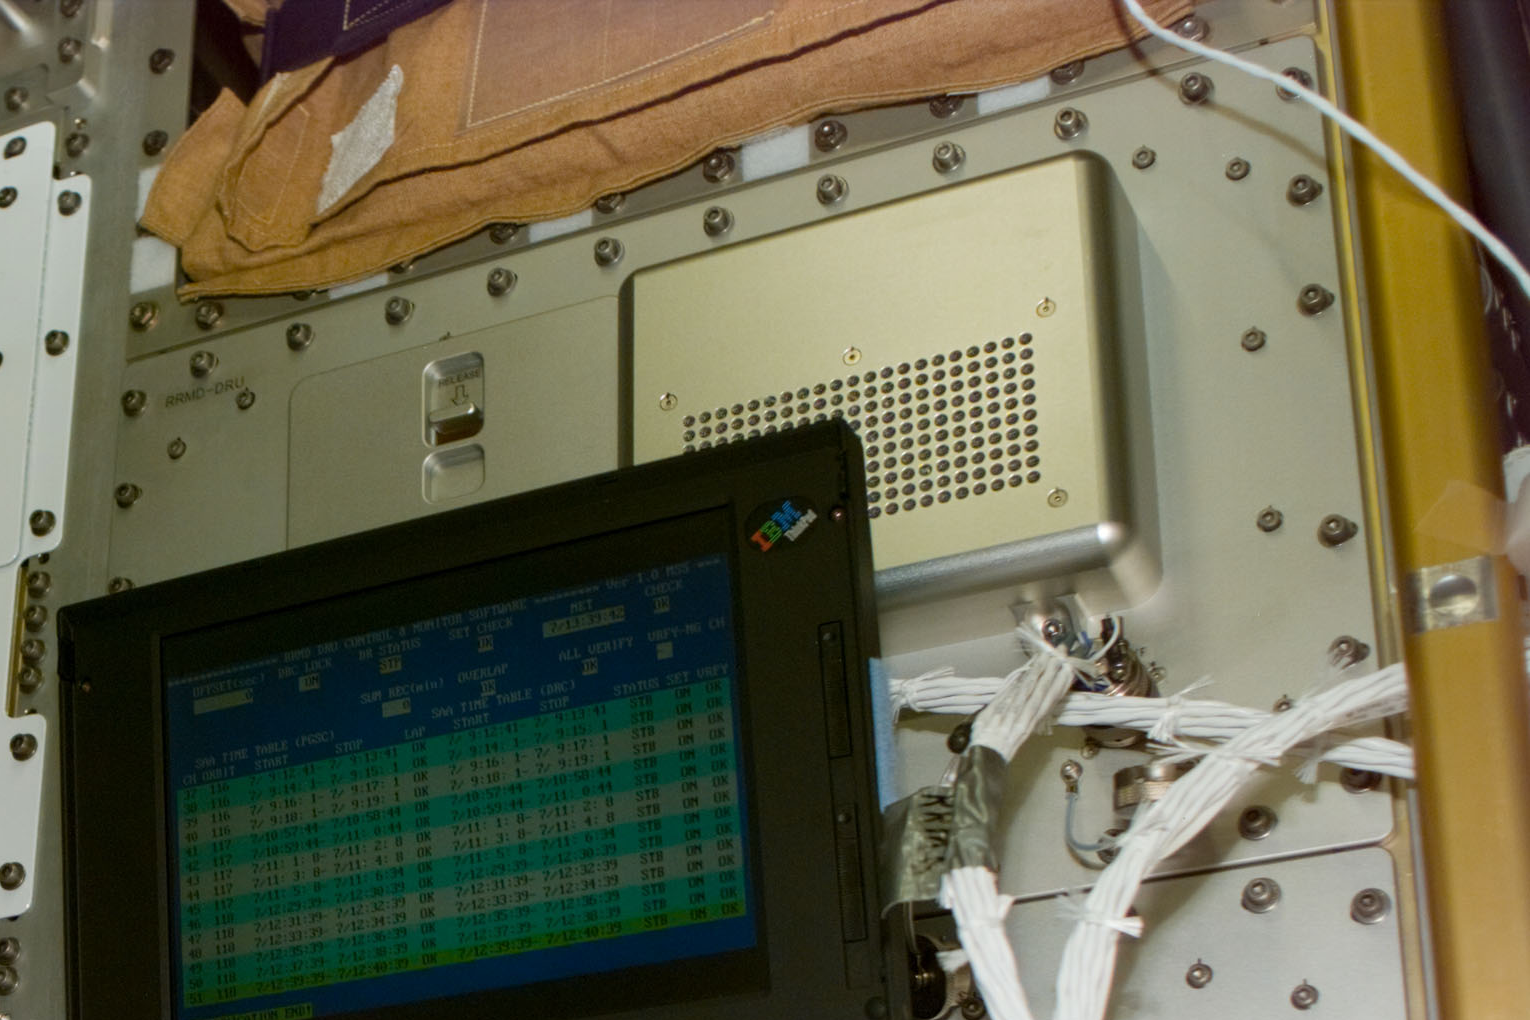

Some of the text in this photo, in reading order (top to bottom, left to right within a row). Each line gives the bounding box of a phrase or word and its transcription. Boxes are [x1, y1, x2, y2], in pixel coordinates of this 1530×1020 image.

[165, 376, 244, 407] RRMD-DRU
[750, 500, 802, 552] IBM
[644, 579, 683, 597] CHECK
[468, 597, 526, 620] SOFTWARE
[475, 615, 513, 634] CHECK
[254, 753, 289, 770] START
[334, 738, 363, 754] STOP
[453, 711, 491, 729] START
[613, 676, 659, 696] STATUS
[418, 891, 435, 905] OK
[639, 849, 663, 866] STB
[685, 842, 703, 857] ON
[717, 836, 734, 851] OK
